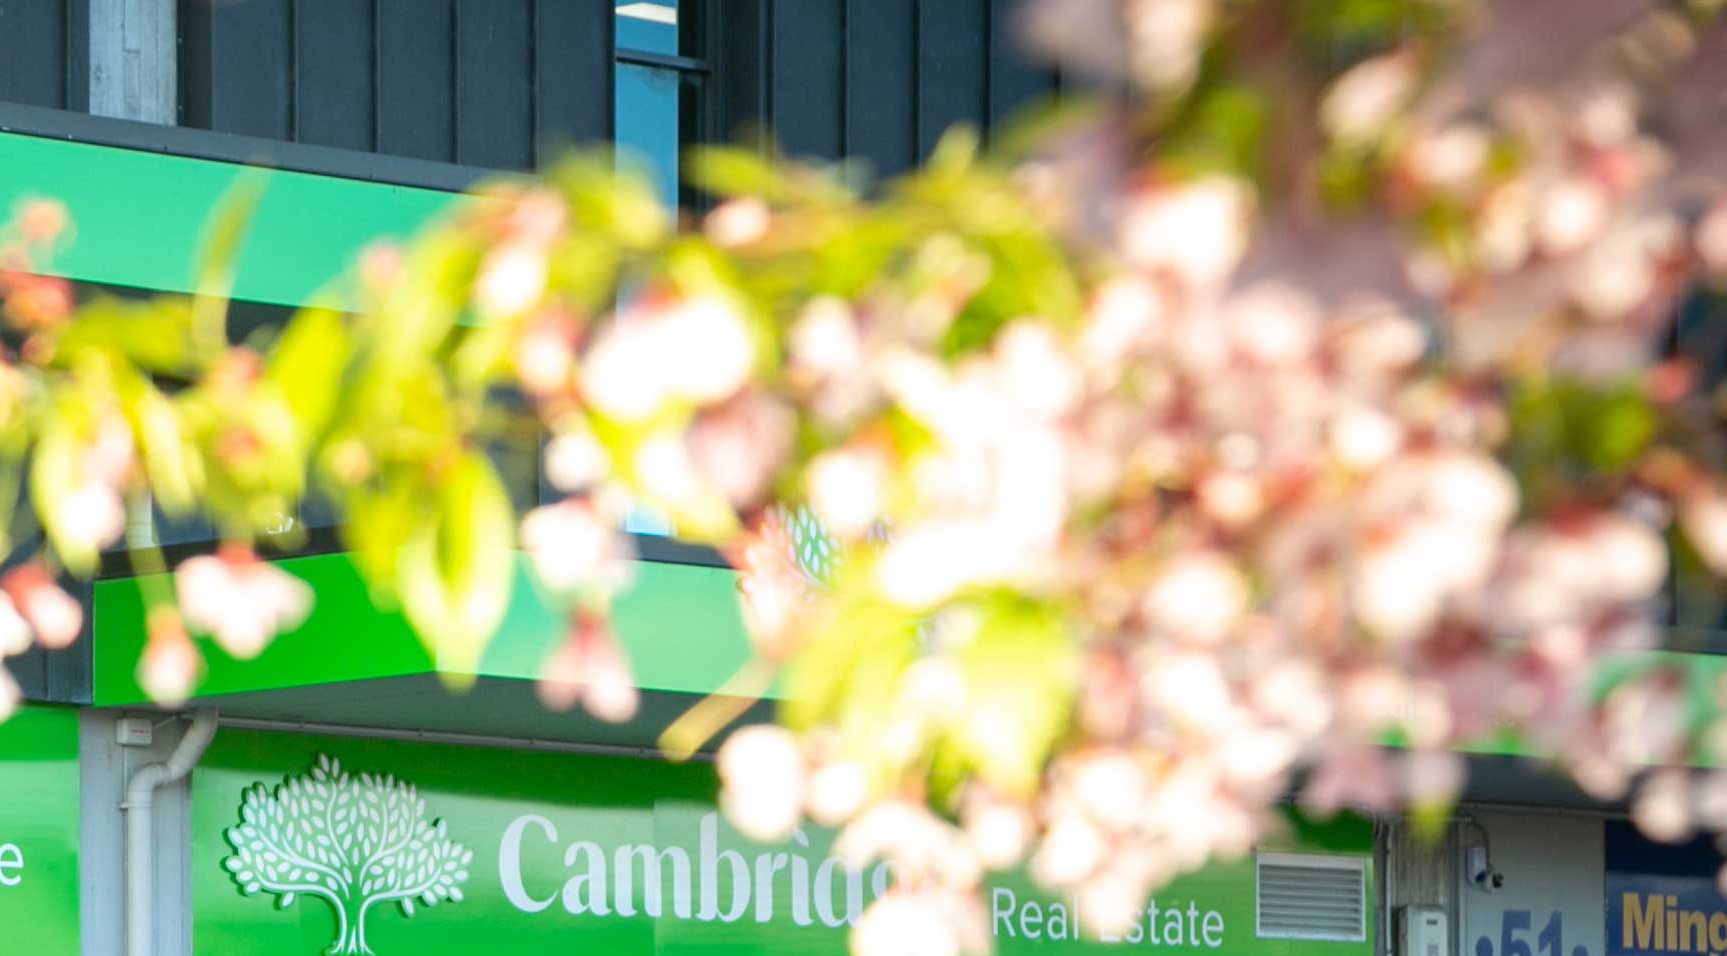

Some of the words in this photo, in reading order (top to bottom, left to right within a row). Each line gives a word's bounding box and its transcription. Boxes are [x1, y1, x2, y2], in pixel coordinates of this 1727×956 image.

[498, 811, 905, 930] Cambrid
[991, 886, 1080, 942] Real
[1099, 897, 1226, 948] state
